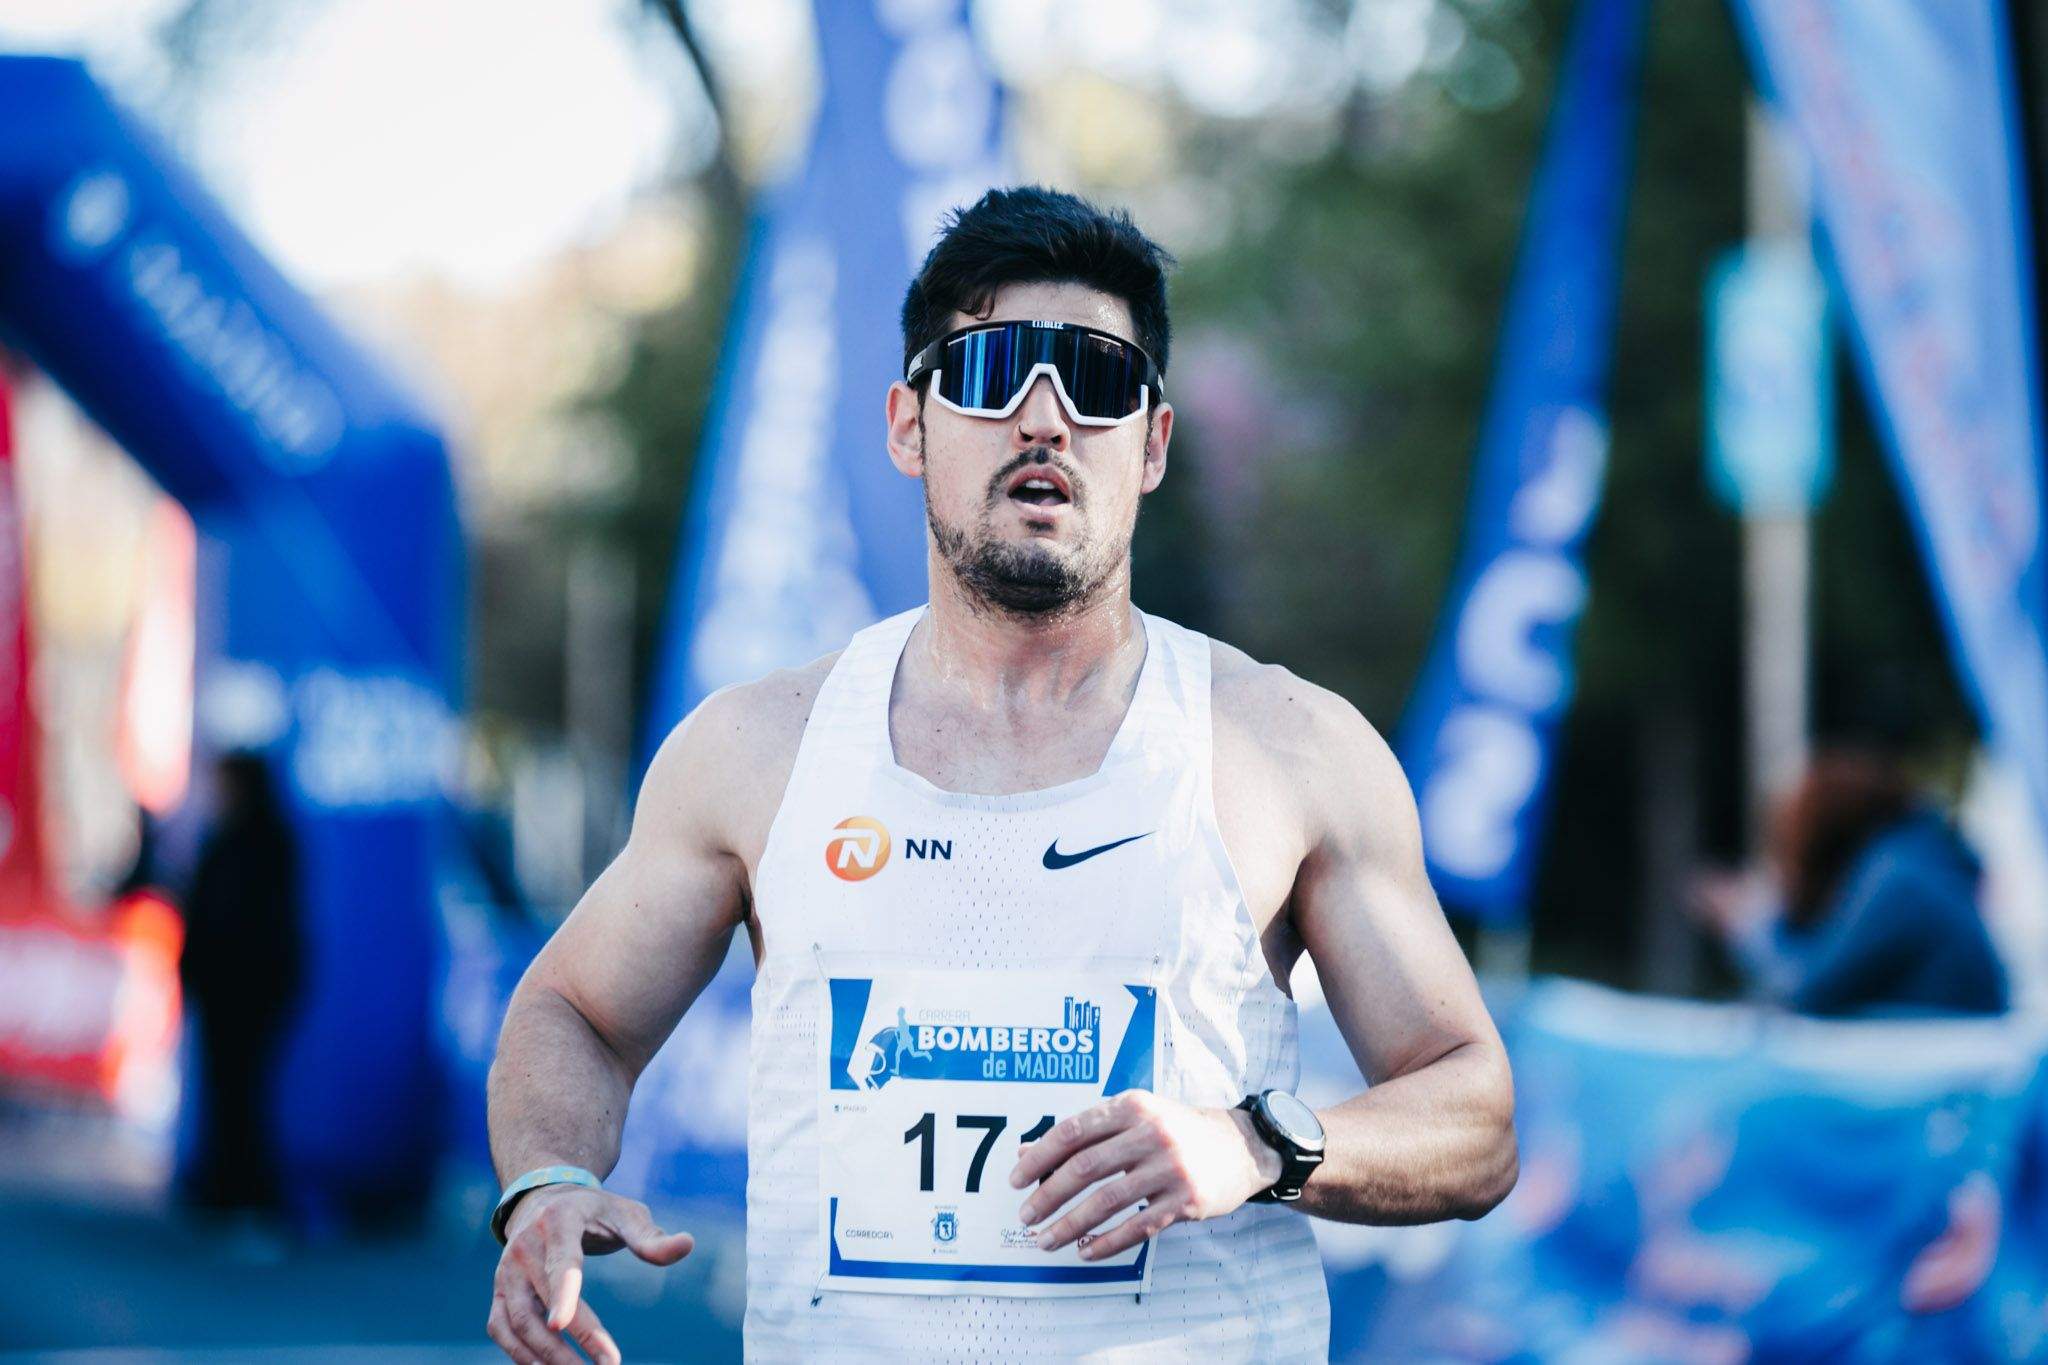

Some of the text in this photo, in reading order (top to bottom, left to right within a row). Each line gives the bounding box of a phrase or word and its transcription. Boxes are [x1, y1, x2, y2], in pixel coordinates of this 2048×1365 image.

[905, 838, 953, 861] NN
[918, 1008, 971, 1023] CARRERA
[917, 1026, 1095, 1054] BOMBEROS
[982, 1053, 1094, 1081] de MADRID
